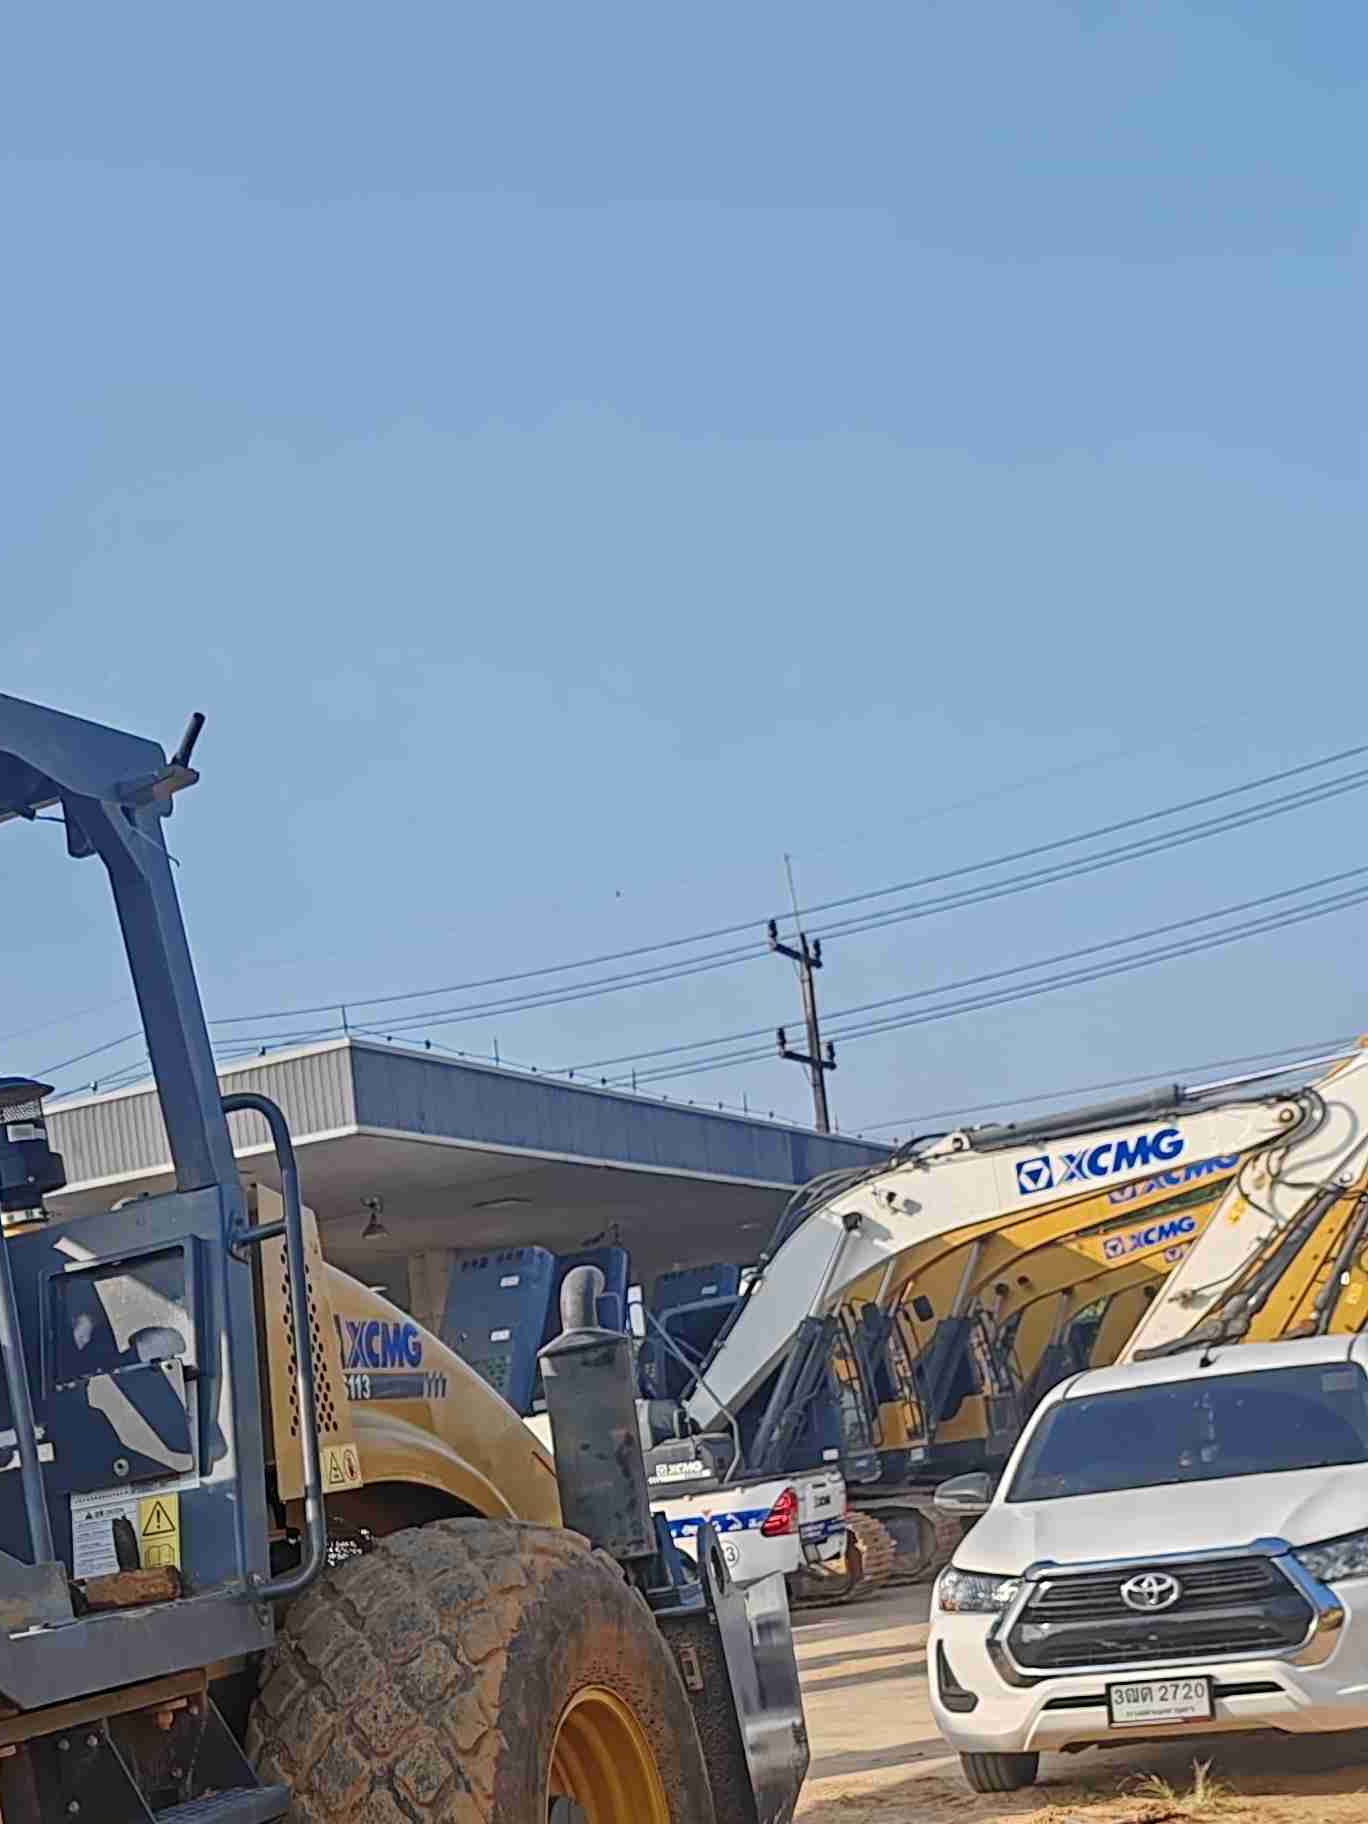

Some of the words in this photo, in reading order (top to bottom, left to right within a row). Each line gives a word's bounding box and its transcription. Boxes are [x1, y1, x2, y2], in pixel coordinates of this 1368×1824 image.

[1056, 1128, 1185, 1184] XCMG
[1130, 1216, 1195, 1250] XCMG
[344, 1320, 422, 1368] XCMG
[1159, 1682, 1205, 1701] 2720
